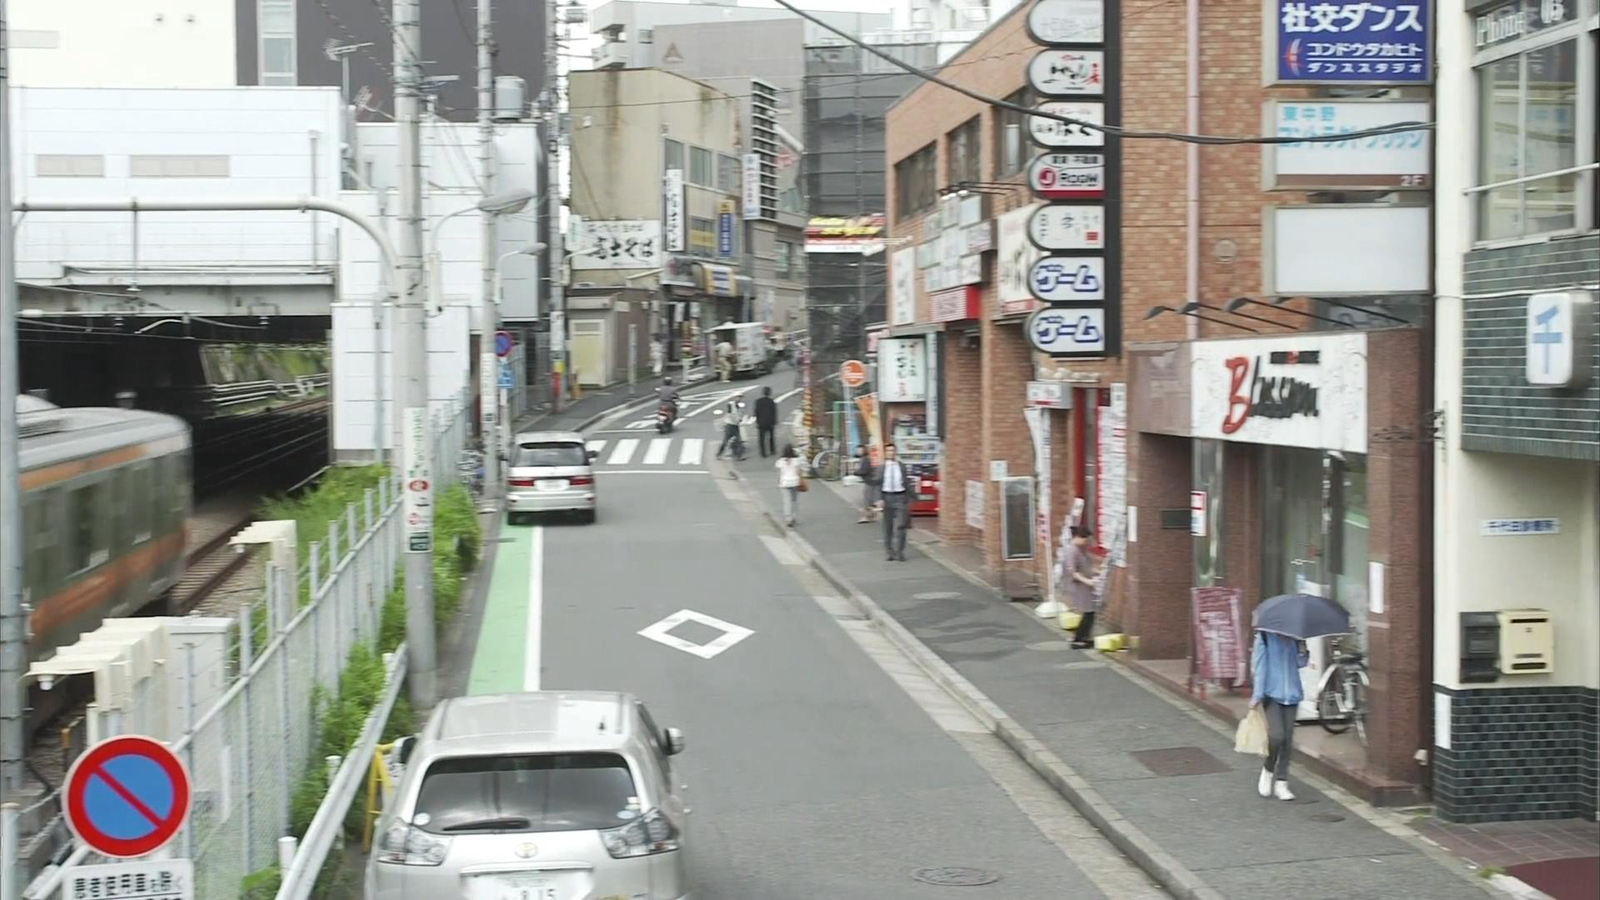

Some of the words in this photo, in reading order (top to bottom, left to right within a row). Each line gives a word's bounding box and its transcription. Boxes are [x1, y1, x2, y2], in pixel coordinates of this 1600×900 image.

[1281, 2, 1424, 33] 社交ダンス
[1306, 43, 1424, 57] コンドウタカヒト
[1283, 106, 1335, 121] 東中野
[1401, 175, 1424, 187] 2F
[1035, 264, 1100, 292] ゲーム
[1036, 315, 1101, 343] ゲーム
